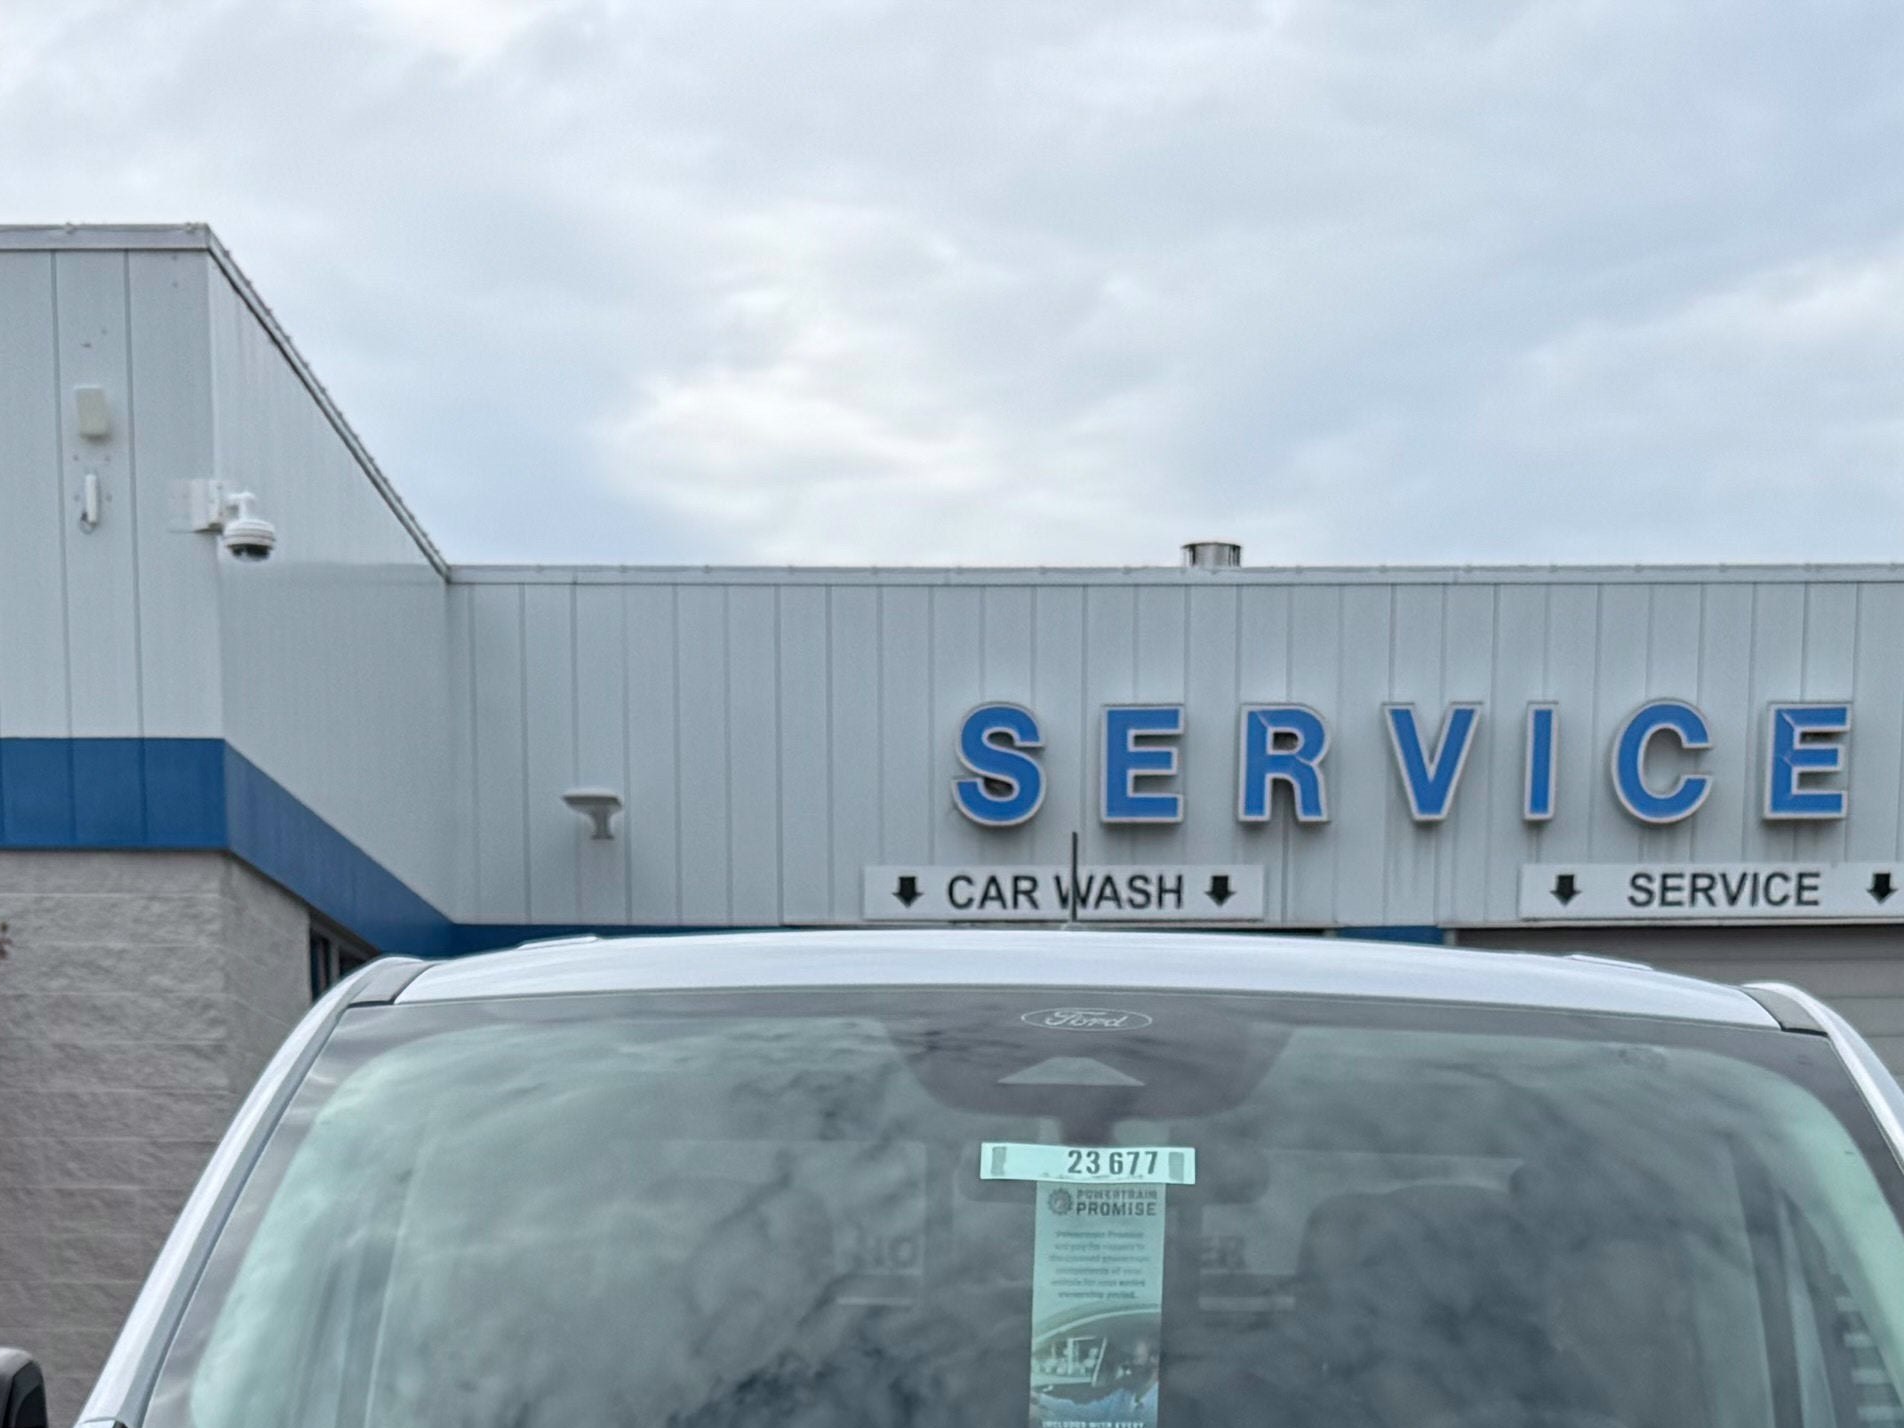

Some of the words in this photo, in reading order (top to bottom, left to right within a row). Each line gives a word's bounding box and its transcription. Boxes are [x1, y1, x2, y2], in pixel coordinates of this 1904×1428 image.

[950, 700, 1852, 827] SERVICE
[947, 874, 1040, 910] CAR
[1054, 874, 1184, 911] WASH
[1627, 872, 1821, 907] SERVICE
[1045, 1011, 1129, 1028] Ford
[1076, 1202, 1158, 1216] PROMISE
